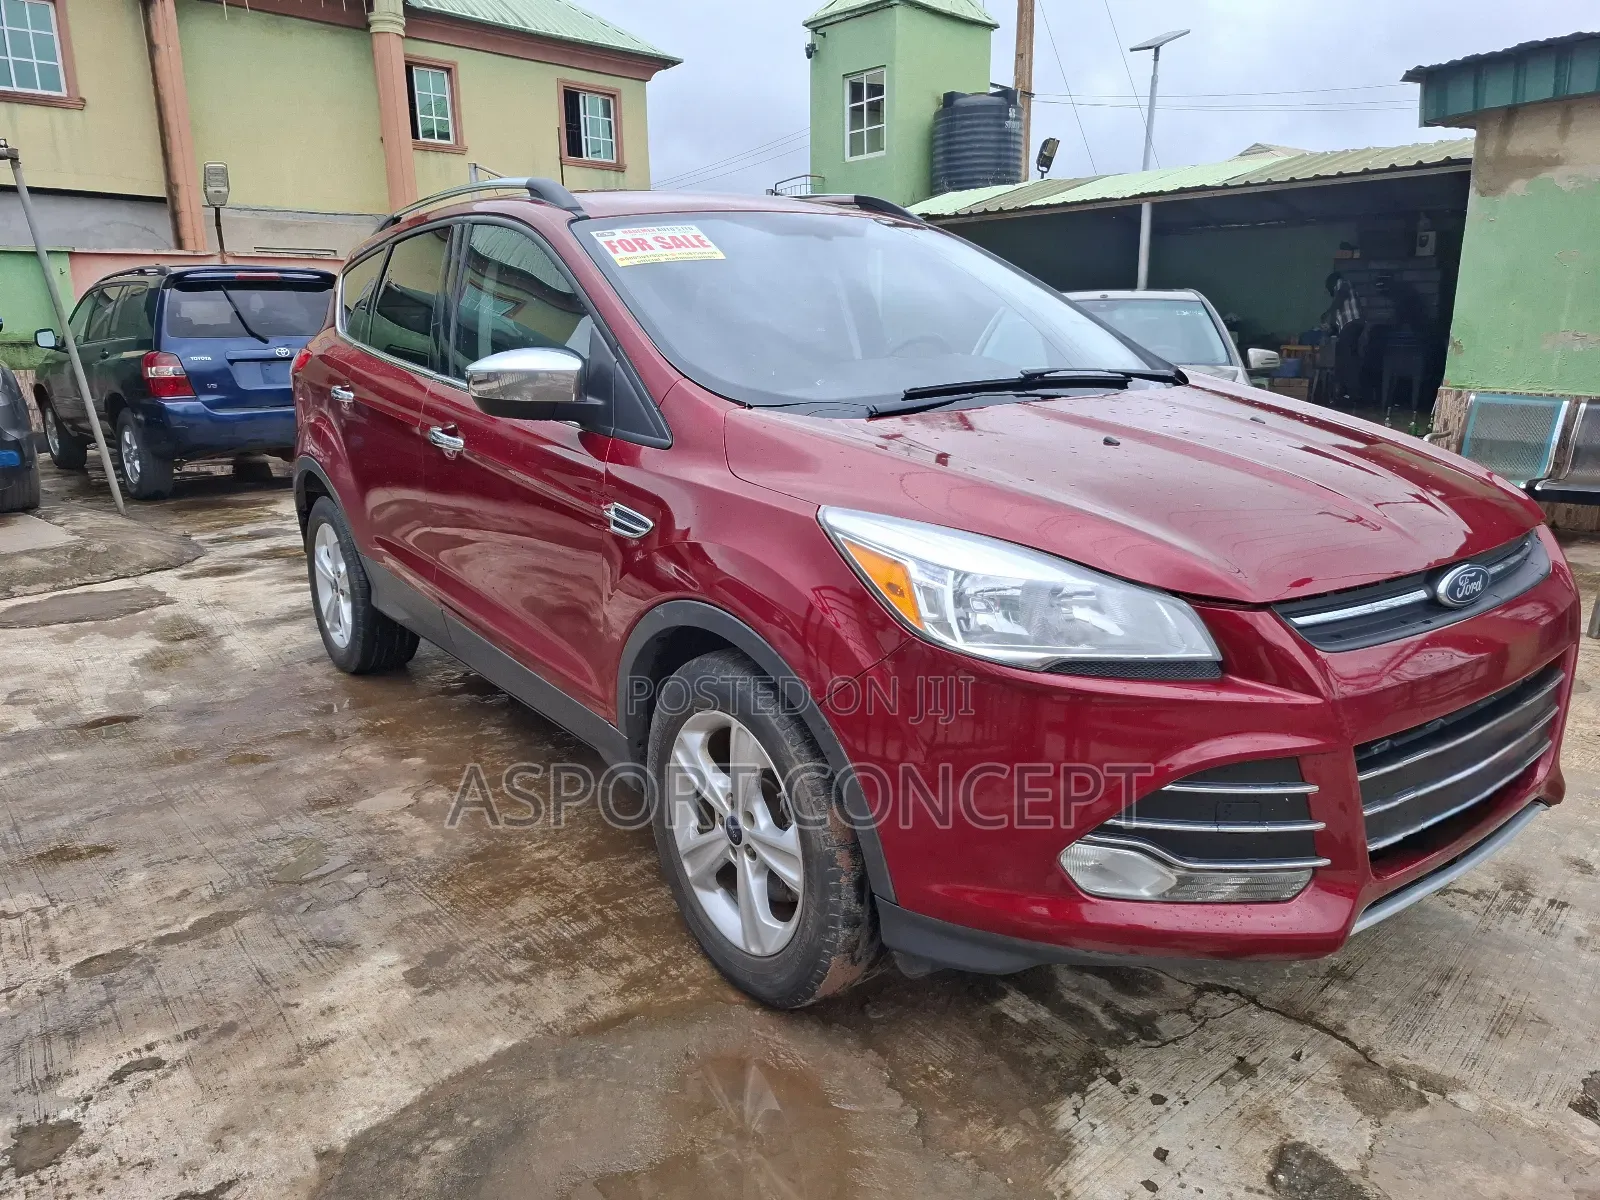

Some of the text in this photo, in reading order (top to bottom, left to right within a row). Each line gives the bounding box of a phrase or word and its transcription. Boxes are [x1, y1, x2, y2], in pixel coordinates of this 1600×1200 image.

[603, 234, 712, 254] FOR SALE
[1456, 571, 1483, 598] Ford
